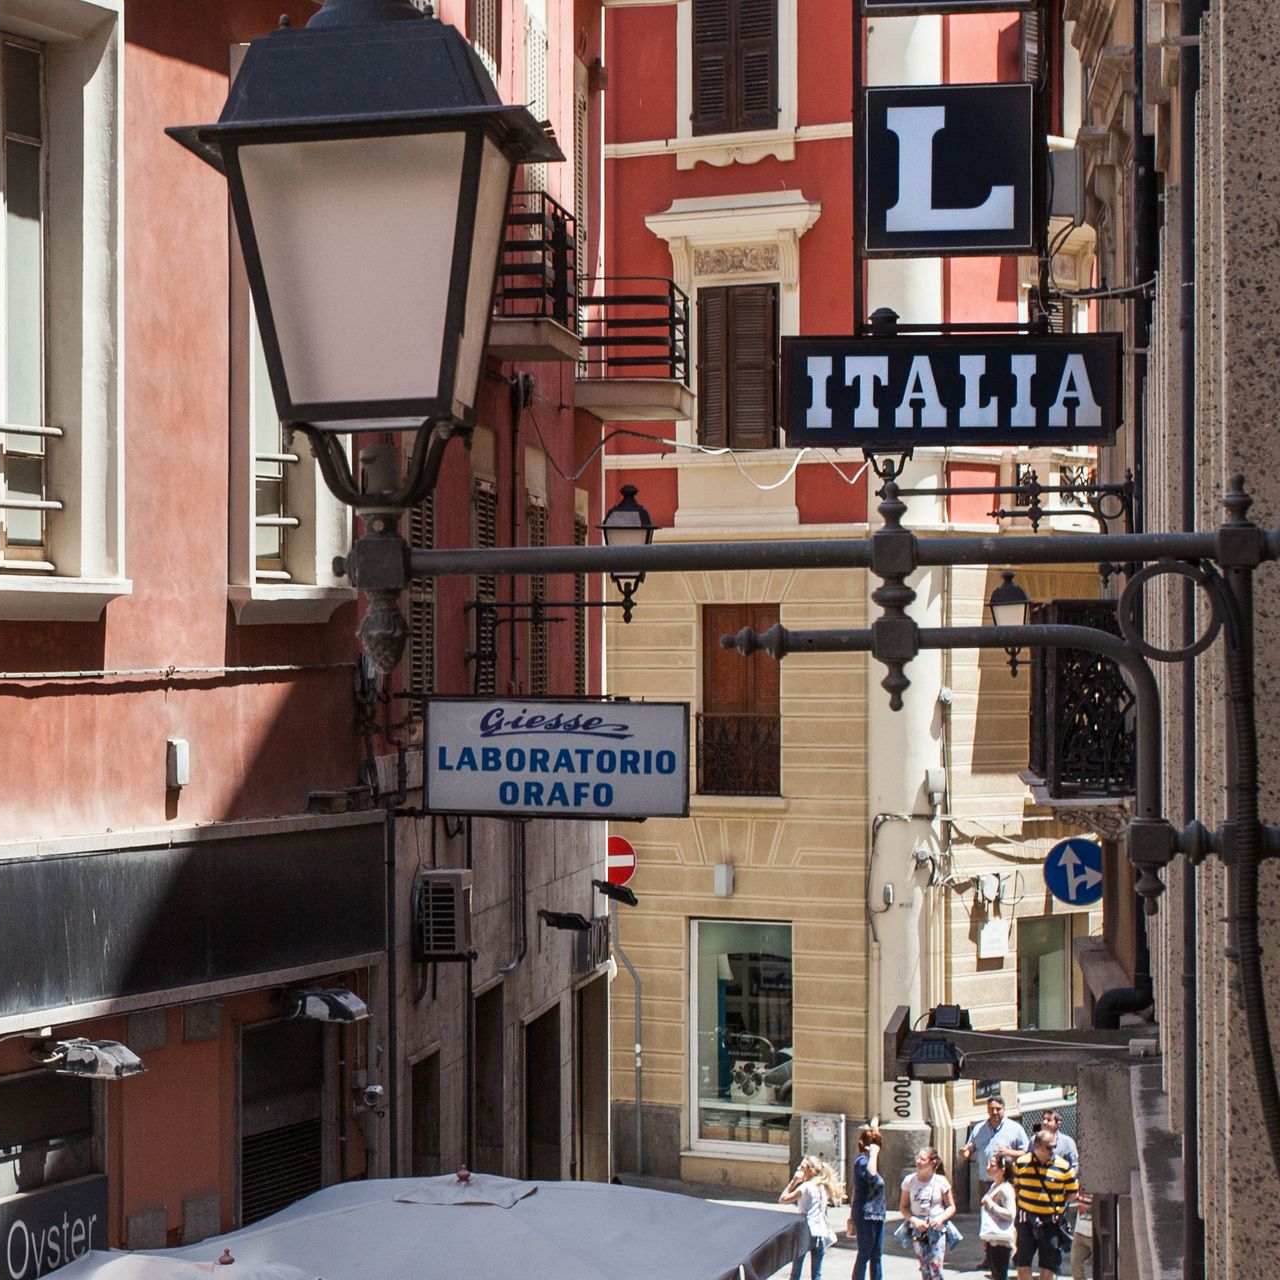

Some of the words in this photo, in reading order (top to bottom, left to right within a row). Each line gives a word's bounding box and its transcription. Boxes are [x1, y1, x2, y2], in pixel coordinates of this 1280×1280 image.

[805, 353, 1102, 428] ITALIA
[480, 707, 632, 738] Giesse
[438, 746, 676, 775] LABORATORIO
[499, 781, 614, 808] ORAFO
[6, 1211, 97, 1280] Oyster
